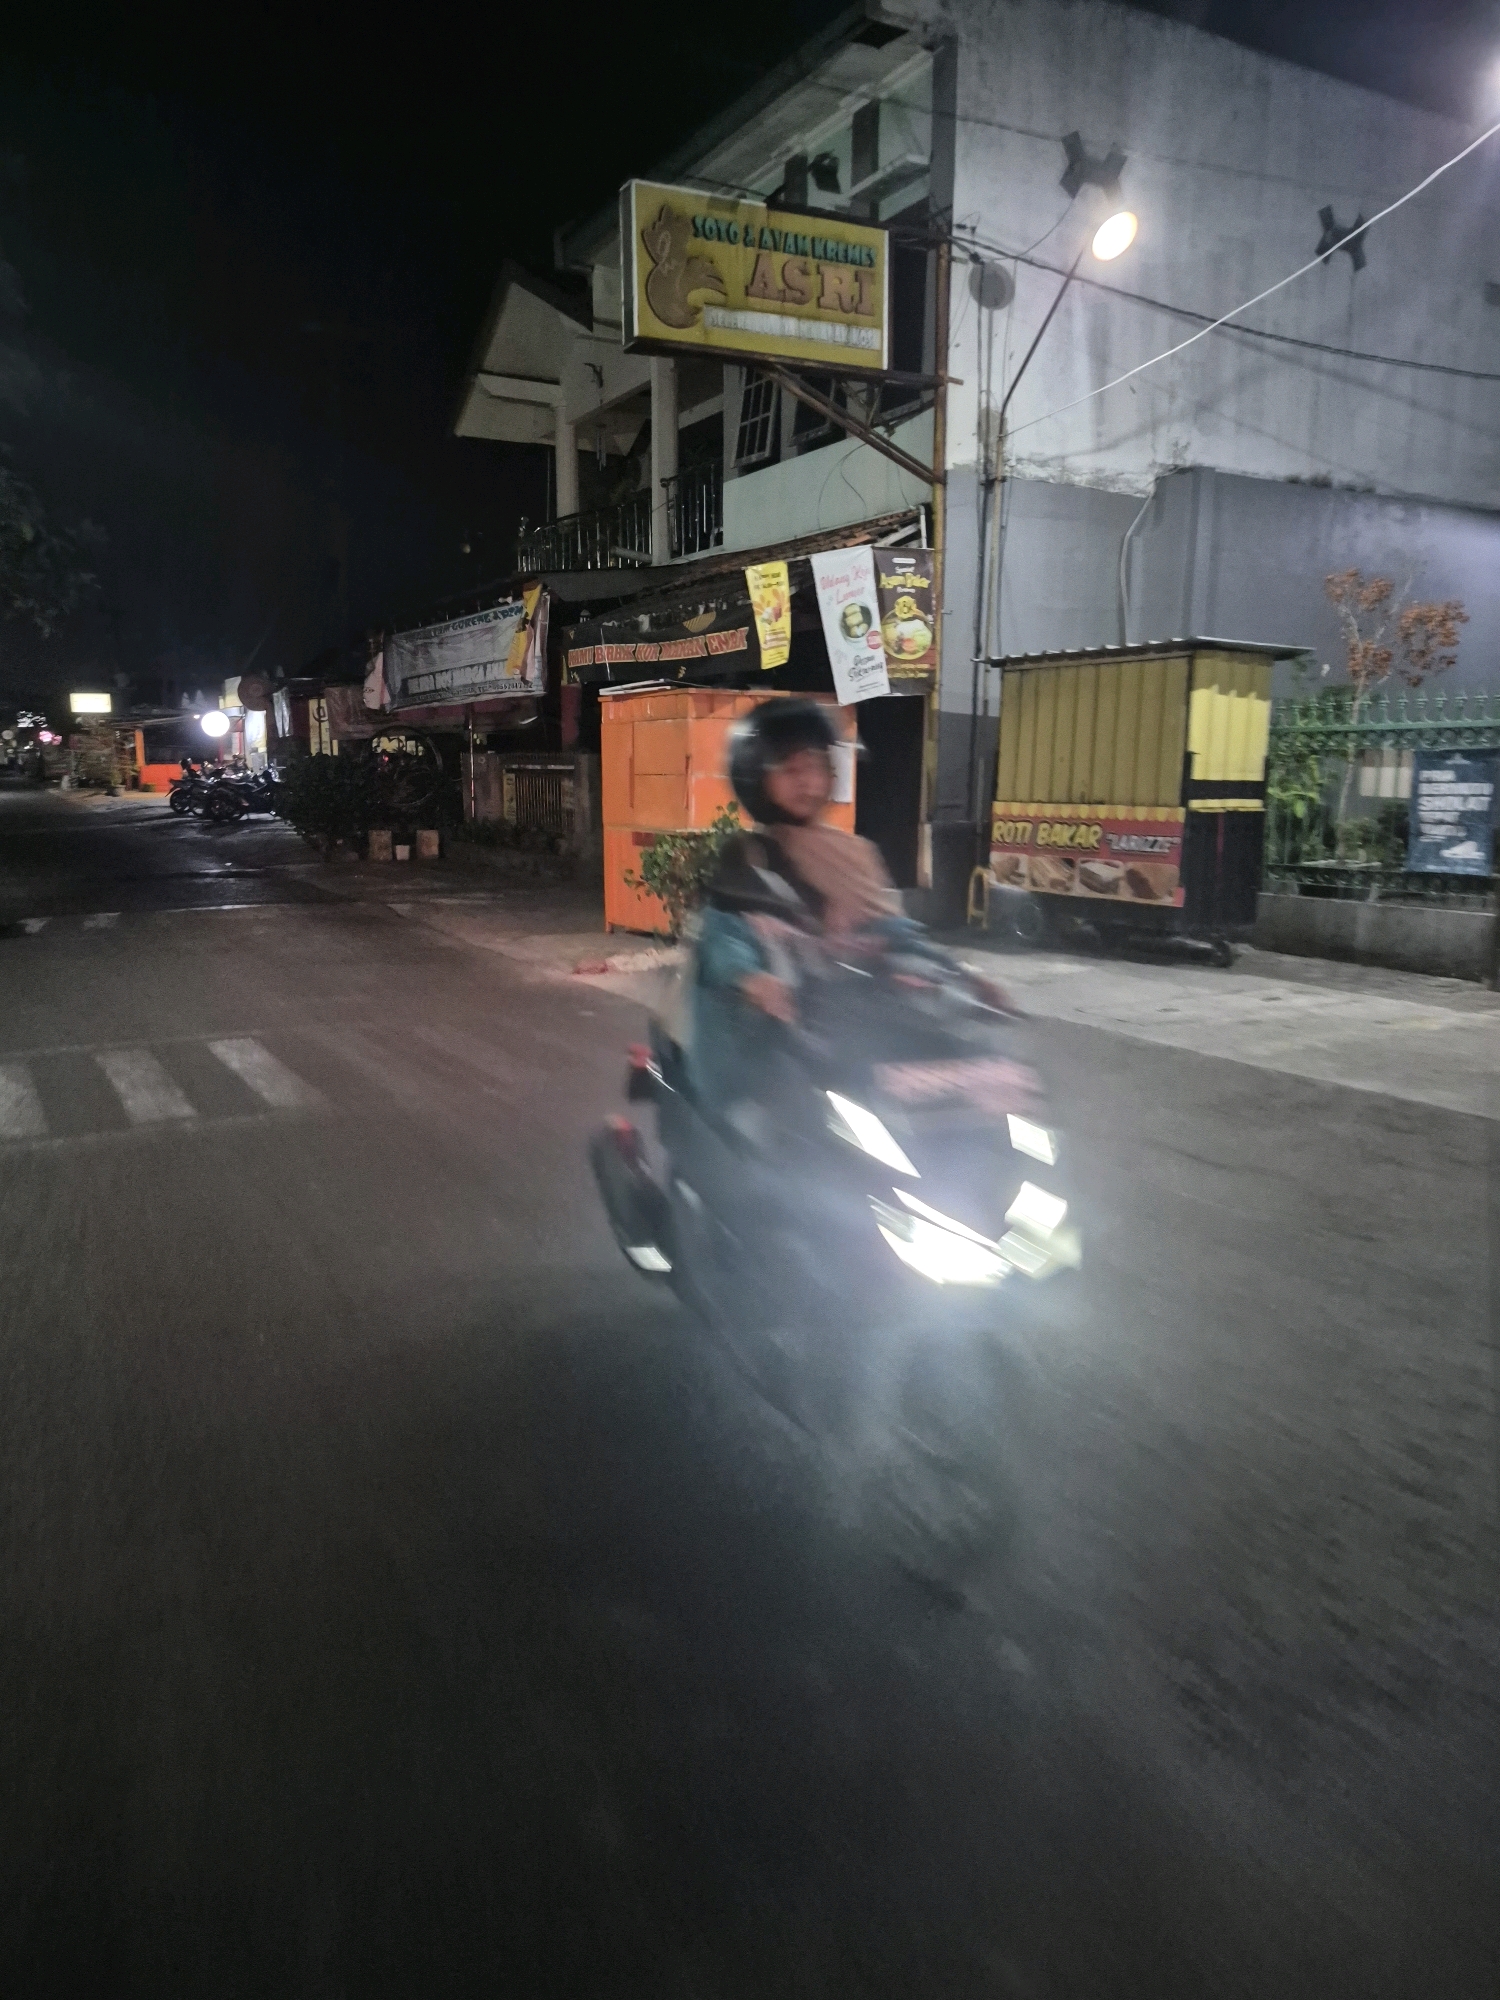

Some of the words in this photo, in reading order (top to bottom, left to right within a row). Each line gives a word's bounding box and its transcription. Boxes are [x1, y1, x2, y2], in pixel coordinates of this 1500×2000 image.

[758, 227, 808, 258] AYAM
[745, 253, 876, 316] ASRI
[991, 819, 1033, 846] ROTI
[1035, 821, 1102, 850] BAKAR
